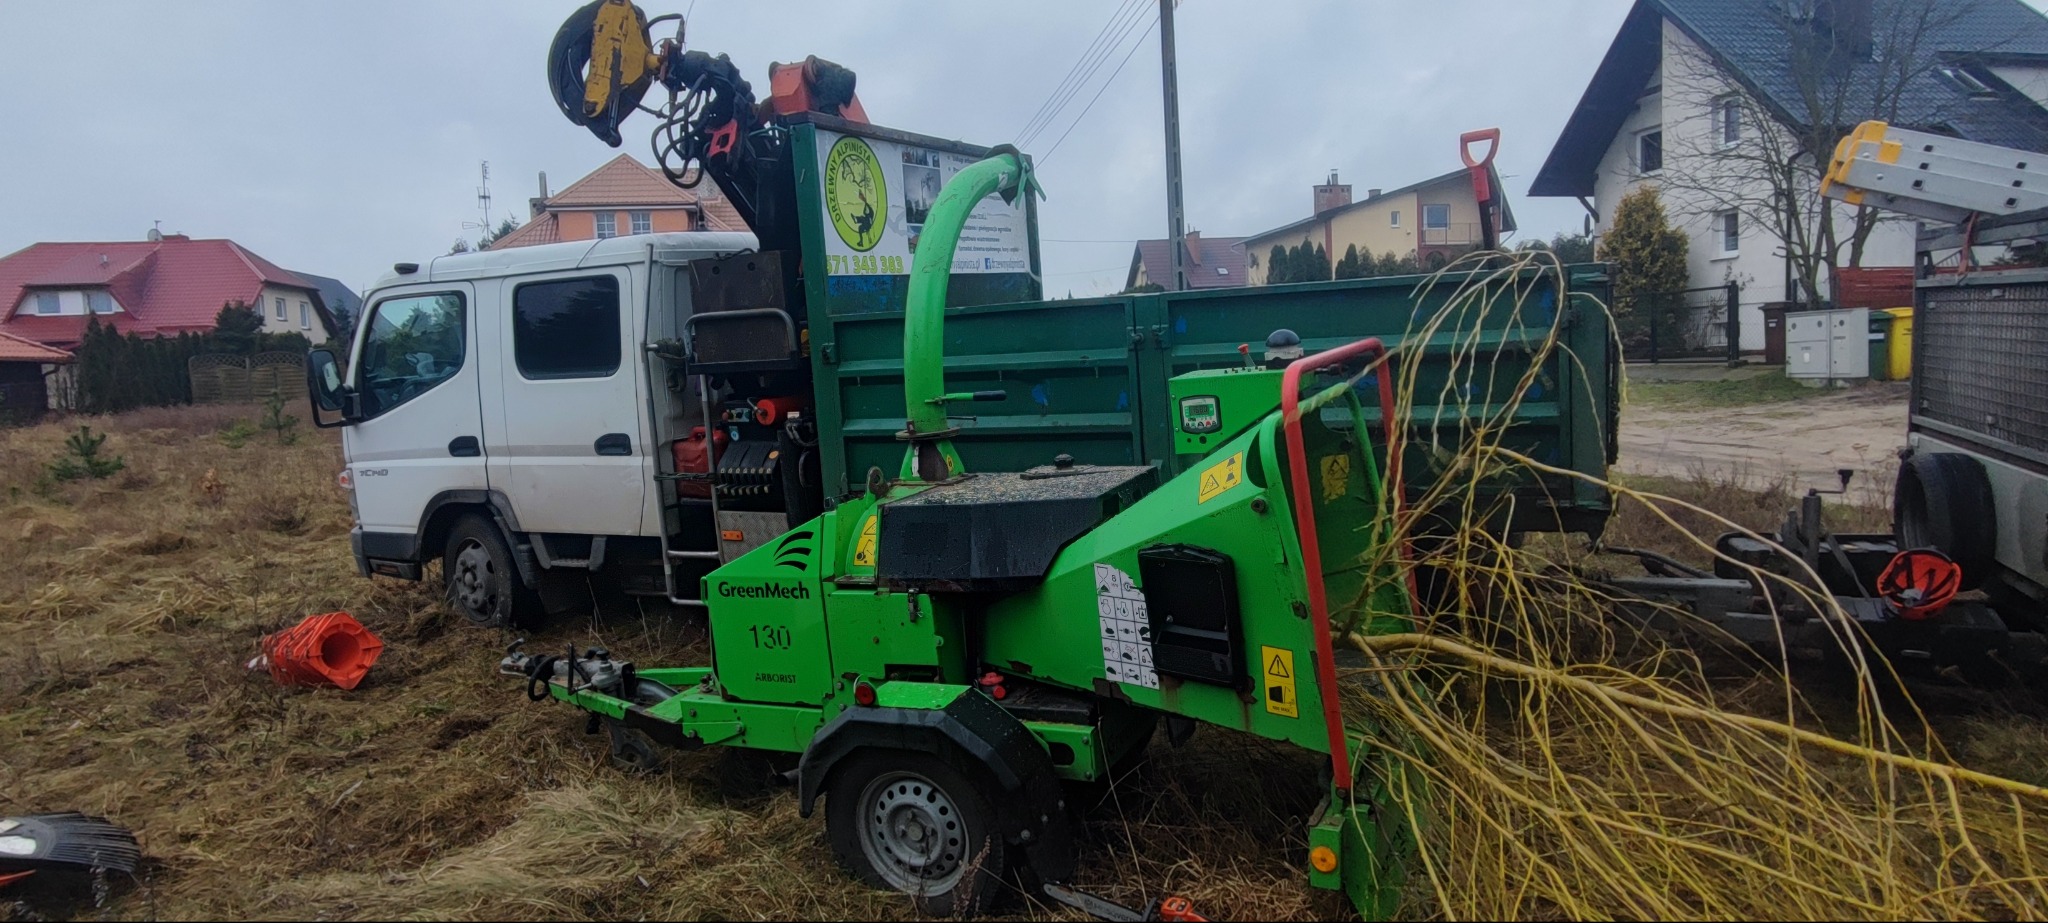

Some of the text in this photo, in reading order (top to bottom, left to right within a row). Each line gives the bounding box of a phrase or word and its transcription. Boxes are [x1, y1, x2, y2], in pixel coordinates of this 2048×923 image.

[828, 142, 872, 223] DRZEWNY ALPINISTA
[852, 254, 878, 274] 343
[879, 255, 904, 274] 383
[718, 581, 810, 600] GreenMech
[748, 624, 792, 650] 130
[755, 672, 797, 684] ARBORIST
